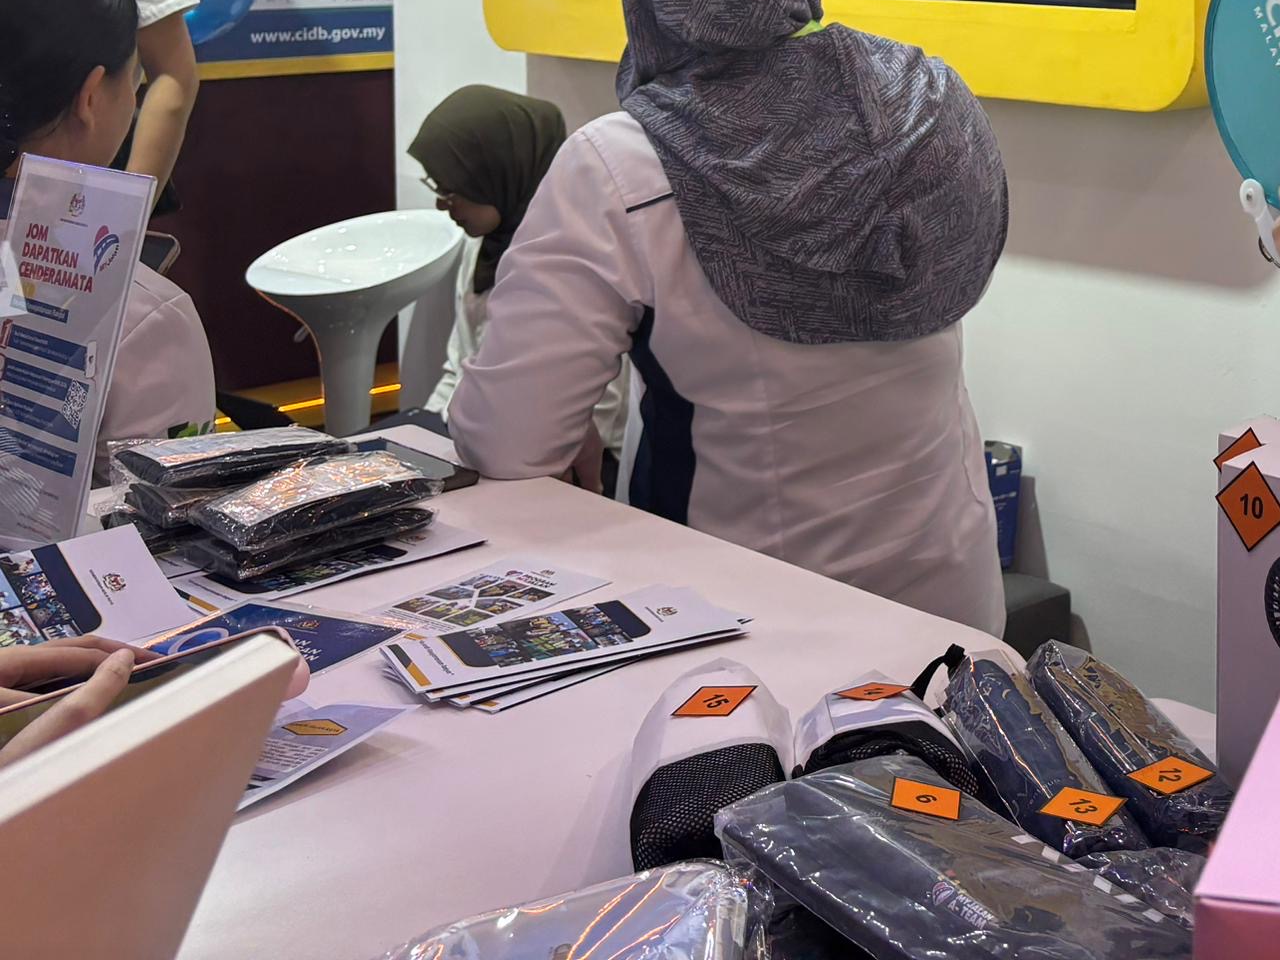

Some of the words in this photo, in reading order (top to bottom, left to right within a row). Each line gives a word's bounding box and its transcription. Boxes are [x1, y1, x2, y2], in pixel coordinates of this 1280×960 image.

[250, 26, 386, 43] www.cidb.gov.my
[26, 223, 49, 242] JOM
[22, 241, 79, 269] DAPATKAN
[19, 260, 93, 293] CENDERAMATA
[1240, 493, 1264, 520] 10
[702, 694, 730, 709] 15
[1158, 767, 1182, 783] 12
[915, 793, 937, 805] 6
[1069, 798, 1098, 814] 13
[960, 905, 988, 931] TEAM
